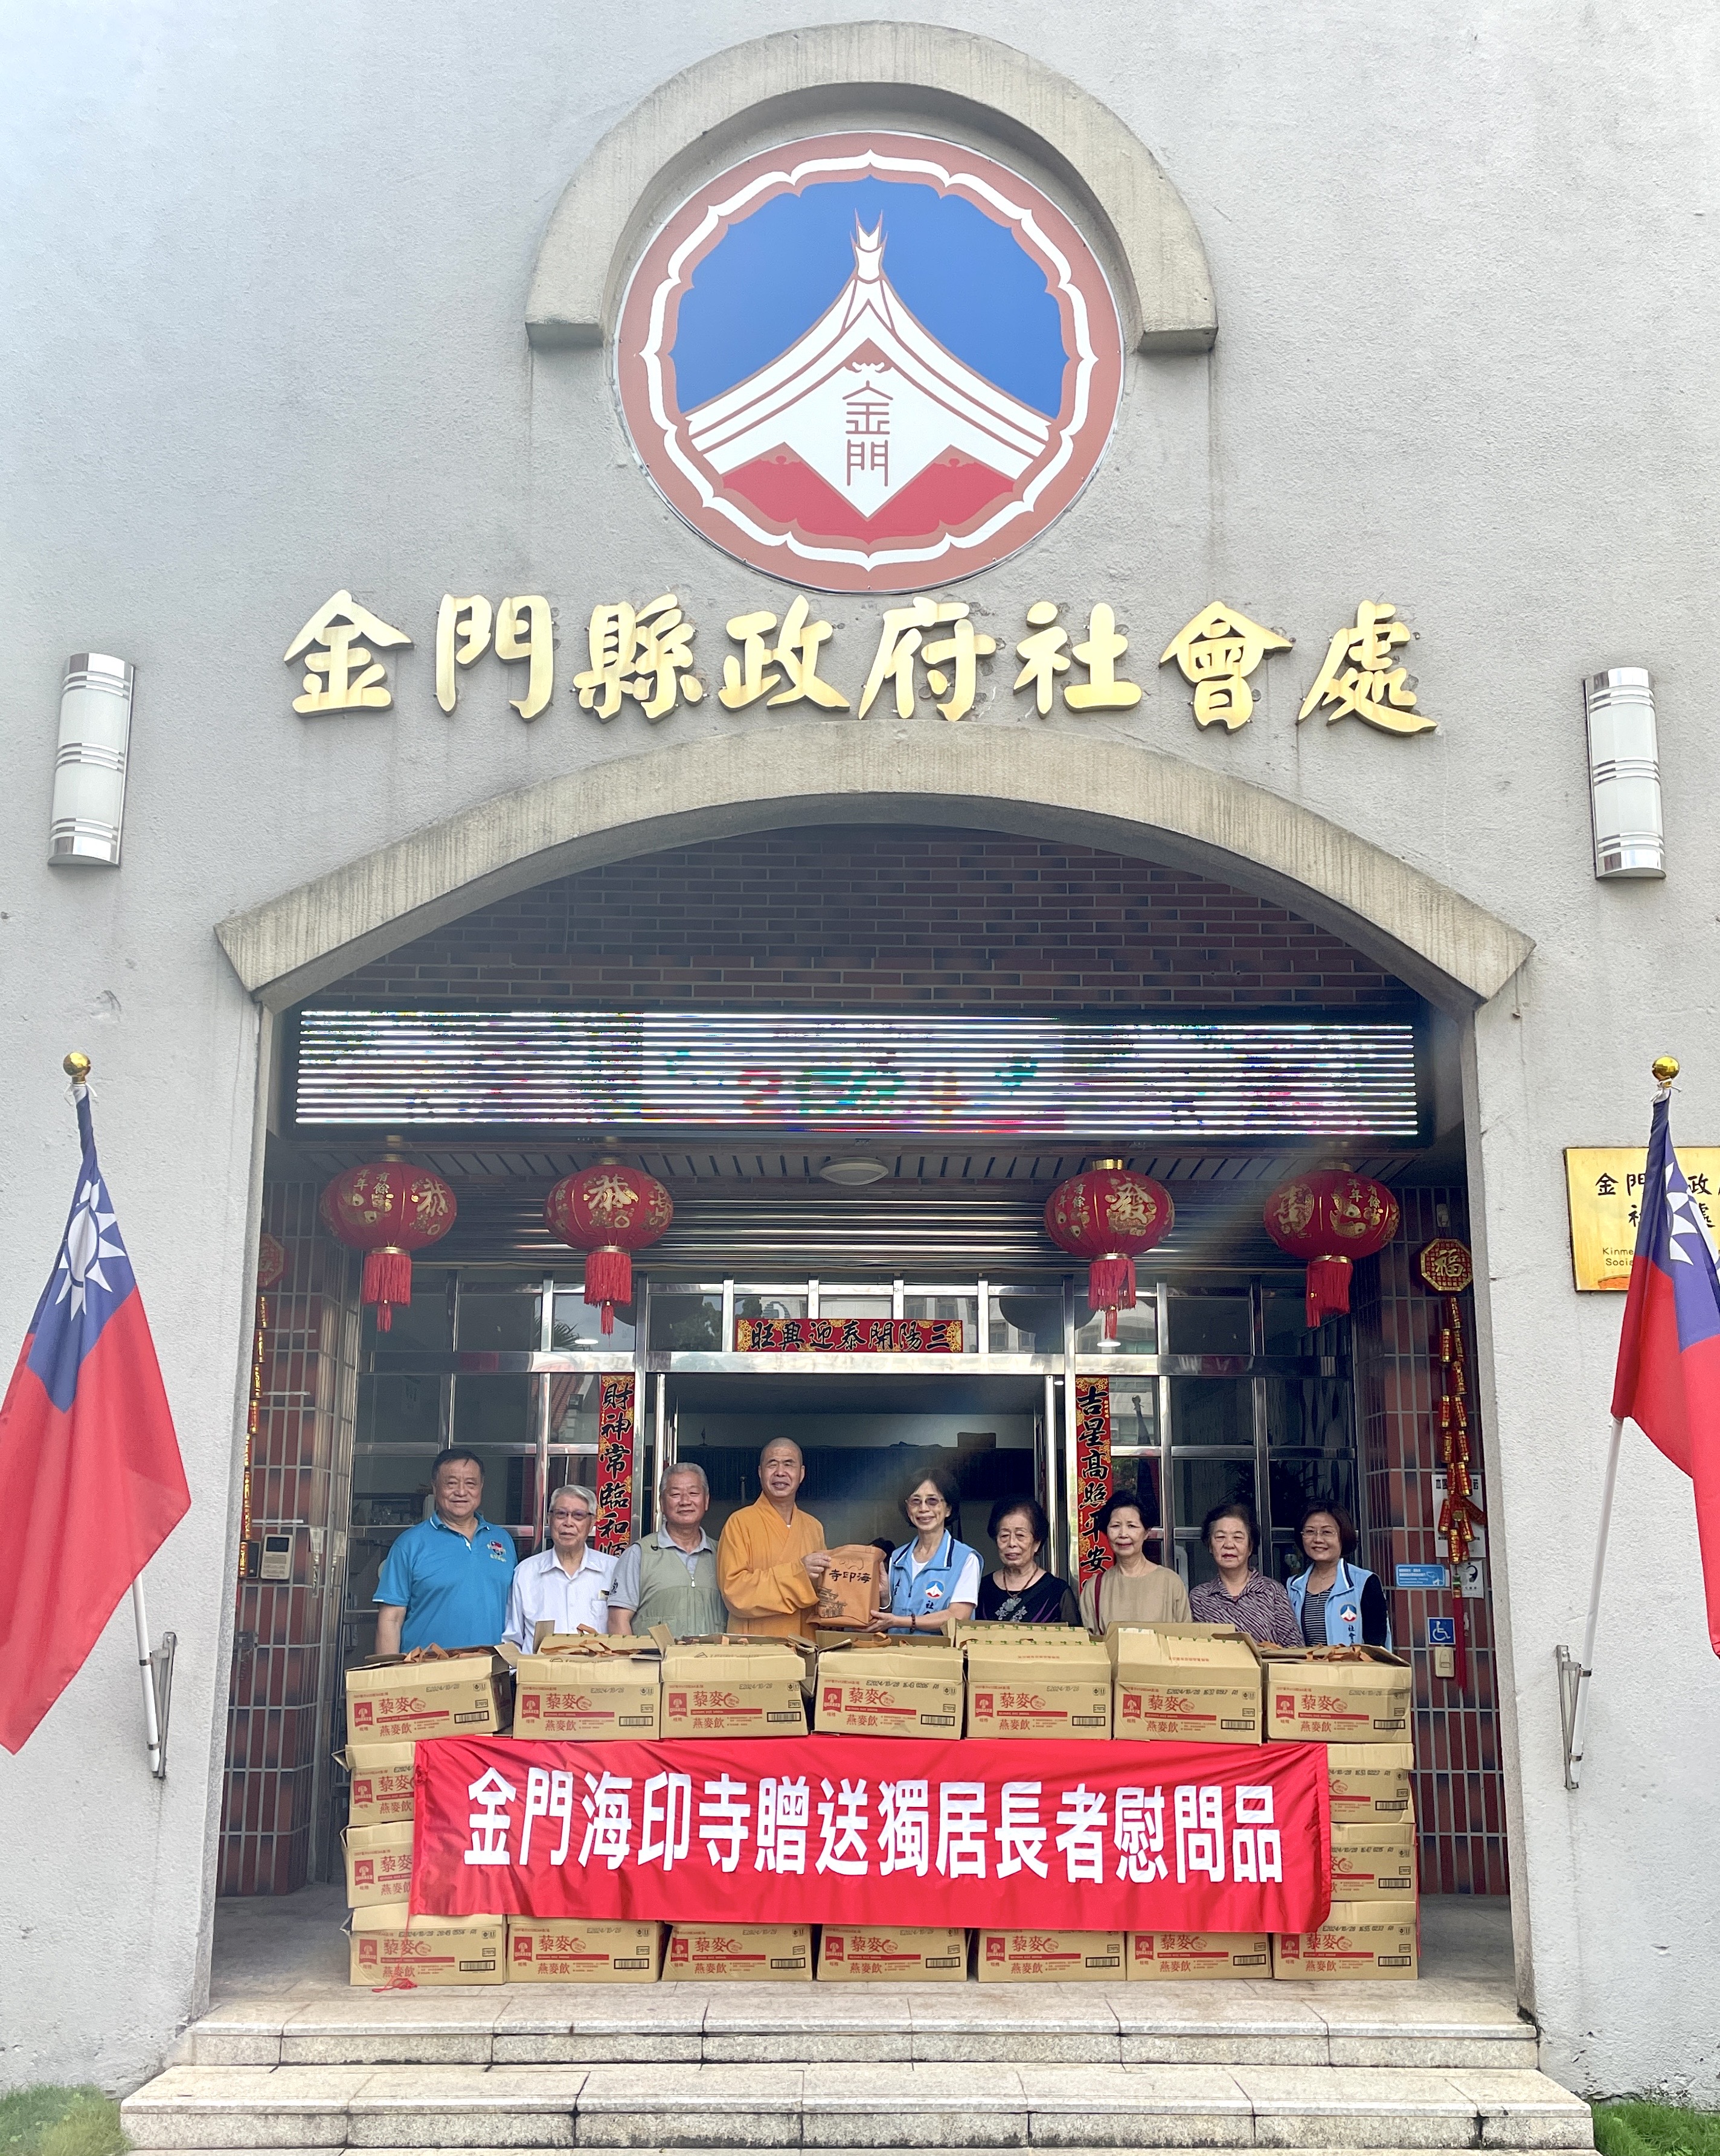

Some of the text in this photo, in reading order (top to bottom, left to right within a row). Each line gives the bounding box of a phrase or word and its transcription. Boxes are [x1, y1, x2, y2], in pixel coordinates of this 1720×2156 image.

[842, 380, 893, 487] 金門
[283, 589, 1438, 736] 金門縣政府社會處
[1602, 1246, 1634, 1255] Kinme
[1433, 1248, 1464, 1277] 福
[1079, 1385, 1112, 1588] 吉星高照平安
[546, 1693, 576, 1710] 藜麥
[693, 1690, 724, 1707] 藜麥
[849, 1687, 879, 1705] 藜麥
[1000, 1692, 1030, 1709] 藜麥
[1149, 1695, 1179, 1712] 藜麥
[1301, 1694, 1332, 1711] 藜麥
[379, 1697, 410, 1714] 藜麥
[545, 1720, 576, 1731] 燕麥飲
[693, 1718, 725, 1729] 燕麥飲
[847, 1714, 878, 1727] 燕麥飲
[999, 1719, 1030, 1731] 燕麥飲
[1147, 1721, 1178, 1733] 燕麥飲
[1300, 1721, 1332, 1733] 燕麥飲
[380, 1722, 412, 1737] 燕麥飲
[378, 1775, 409, 1792] 藜麥
[379, 1800, 412, 1814] 燕麥飲
[463, 1766, 1283, 1883] 金門海印寺贈送獨居長者慰問品
[539, 1934, 570, 1952] 藜麥
[695, 1937, 725, 1953] 藜麥
[851, 1936, 882, 1952] 藜麥
[1012, 1936, 1043, 1952] 藜麥
[1161, 1934, 1191, 1950] 藜麥
[1306, 1934, 1337, 1950] 藜麥
[538, 1963, 570, 1975] 燕麥飲
[695, 1963, 727, 1974] 燕麥飲
[850, 1963, 882, 1974] 燕麥飲
[1011, 1963, 1043, 1974] 燕麥飲
[1160, 1960, 1191, 1972] 燕麥飲
[1305, 1960, 1337, 1972] 燕麥飲
